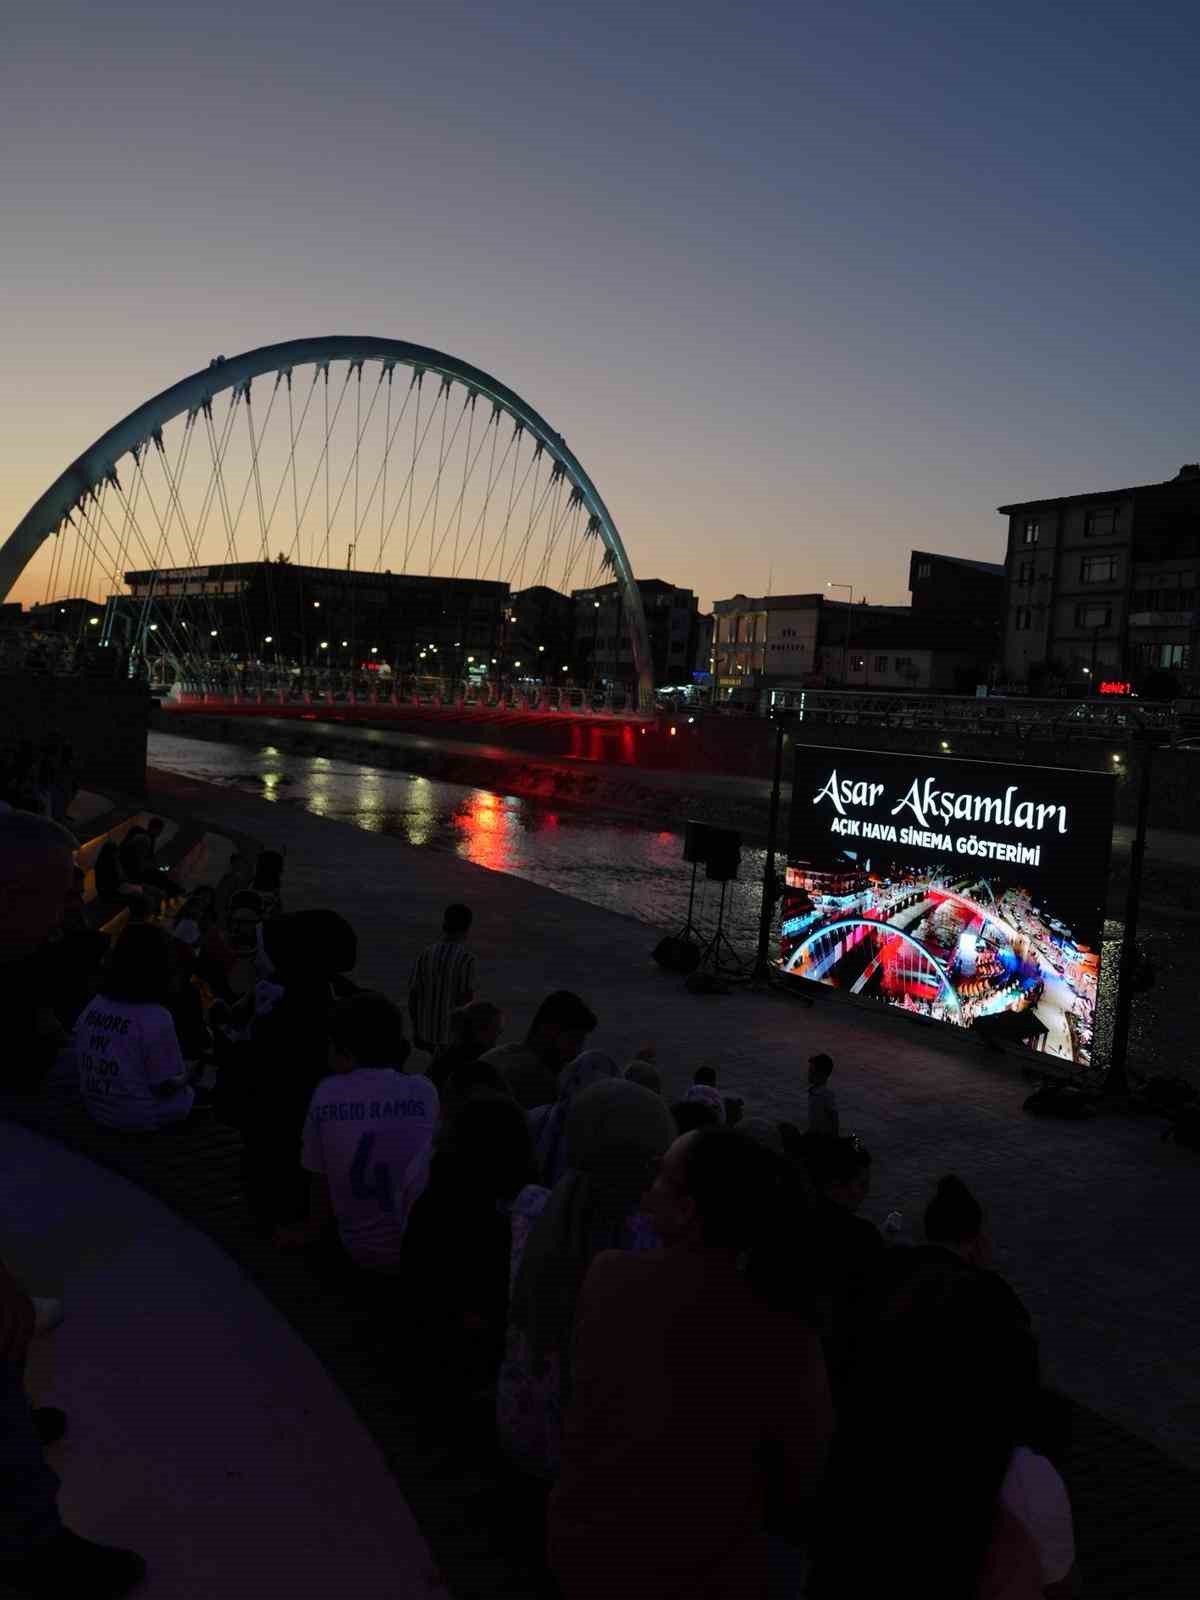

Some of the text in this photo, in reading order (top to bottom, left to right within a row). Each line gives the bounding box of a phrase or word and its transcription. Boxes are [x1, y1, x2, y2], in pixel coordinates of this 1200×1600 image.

[812, 769, 1068, 834] Asar Akşamları
[830, 817, 1041, 867] AÇIK HAVA SİNEMA GÖSTERİMİ
[348, 1131, 394, 1212] 4
